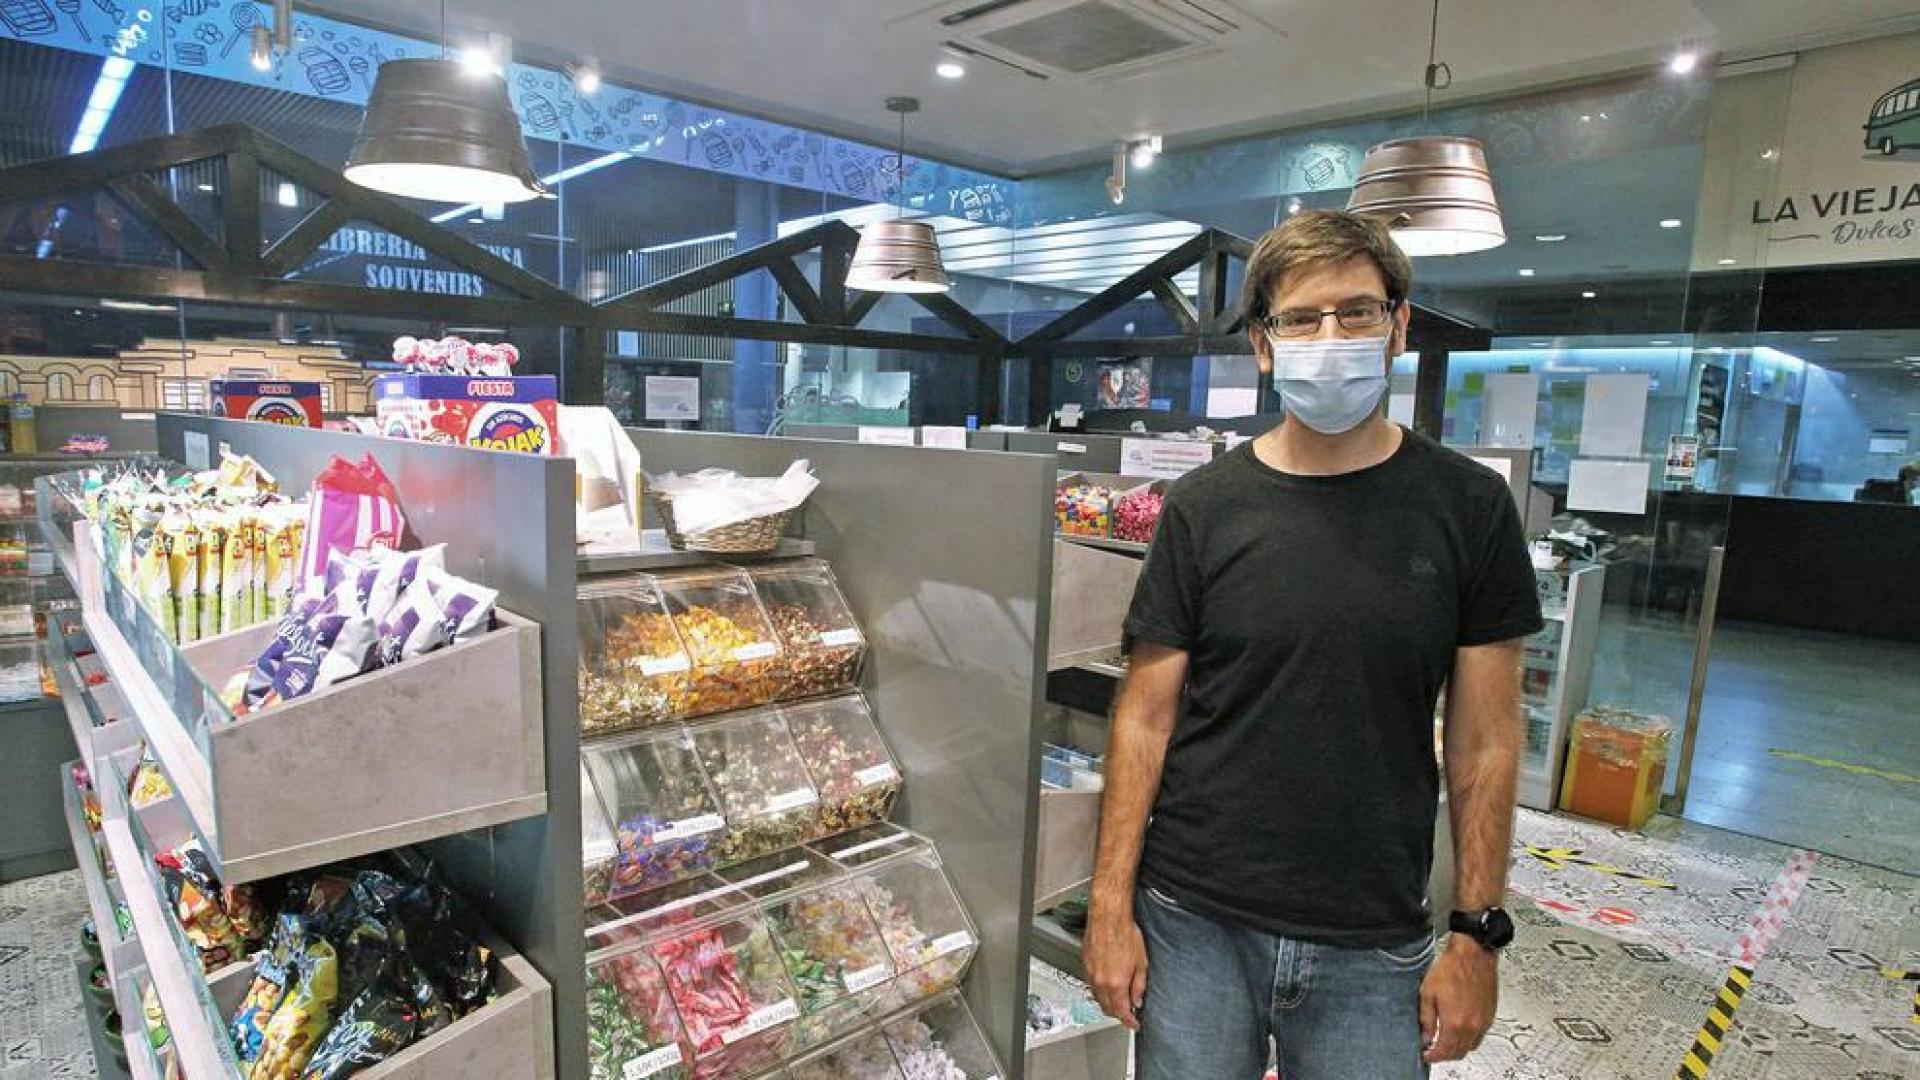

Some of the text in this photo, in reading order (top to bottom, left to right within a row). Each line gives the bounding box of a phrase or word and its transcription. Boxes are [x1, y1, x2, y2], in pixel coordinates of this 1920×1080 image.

[1752, 183, 1920, 224] LA VIEJA
[318, 228, 427, 261] IBRERIA
[365, 263, 483, 297] SOUVENIRS
[469, 381, 514, 396] FIESTA
